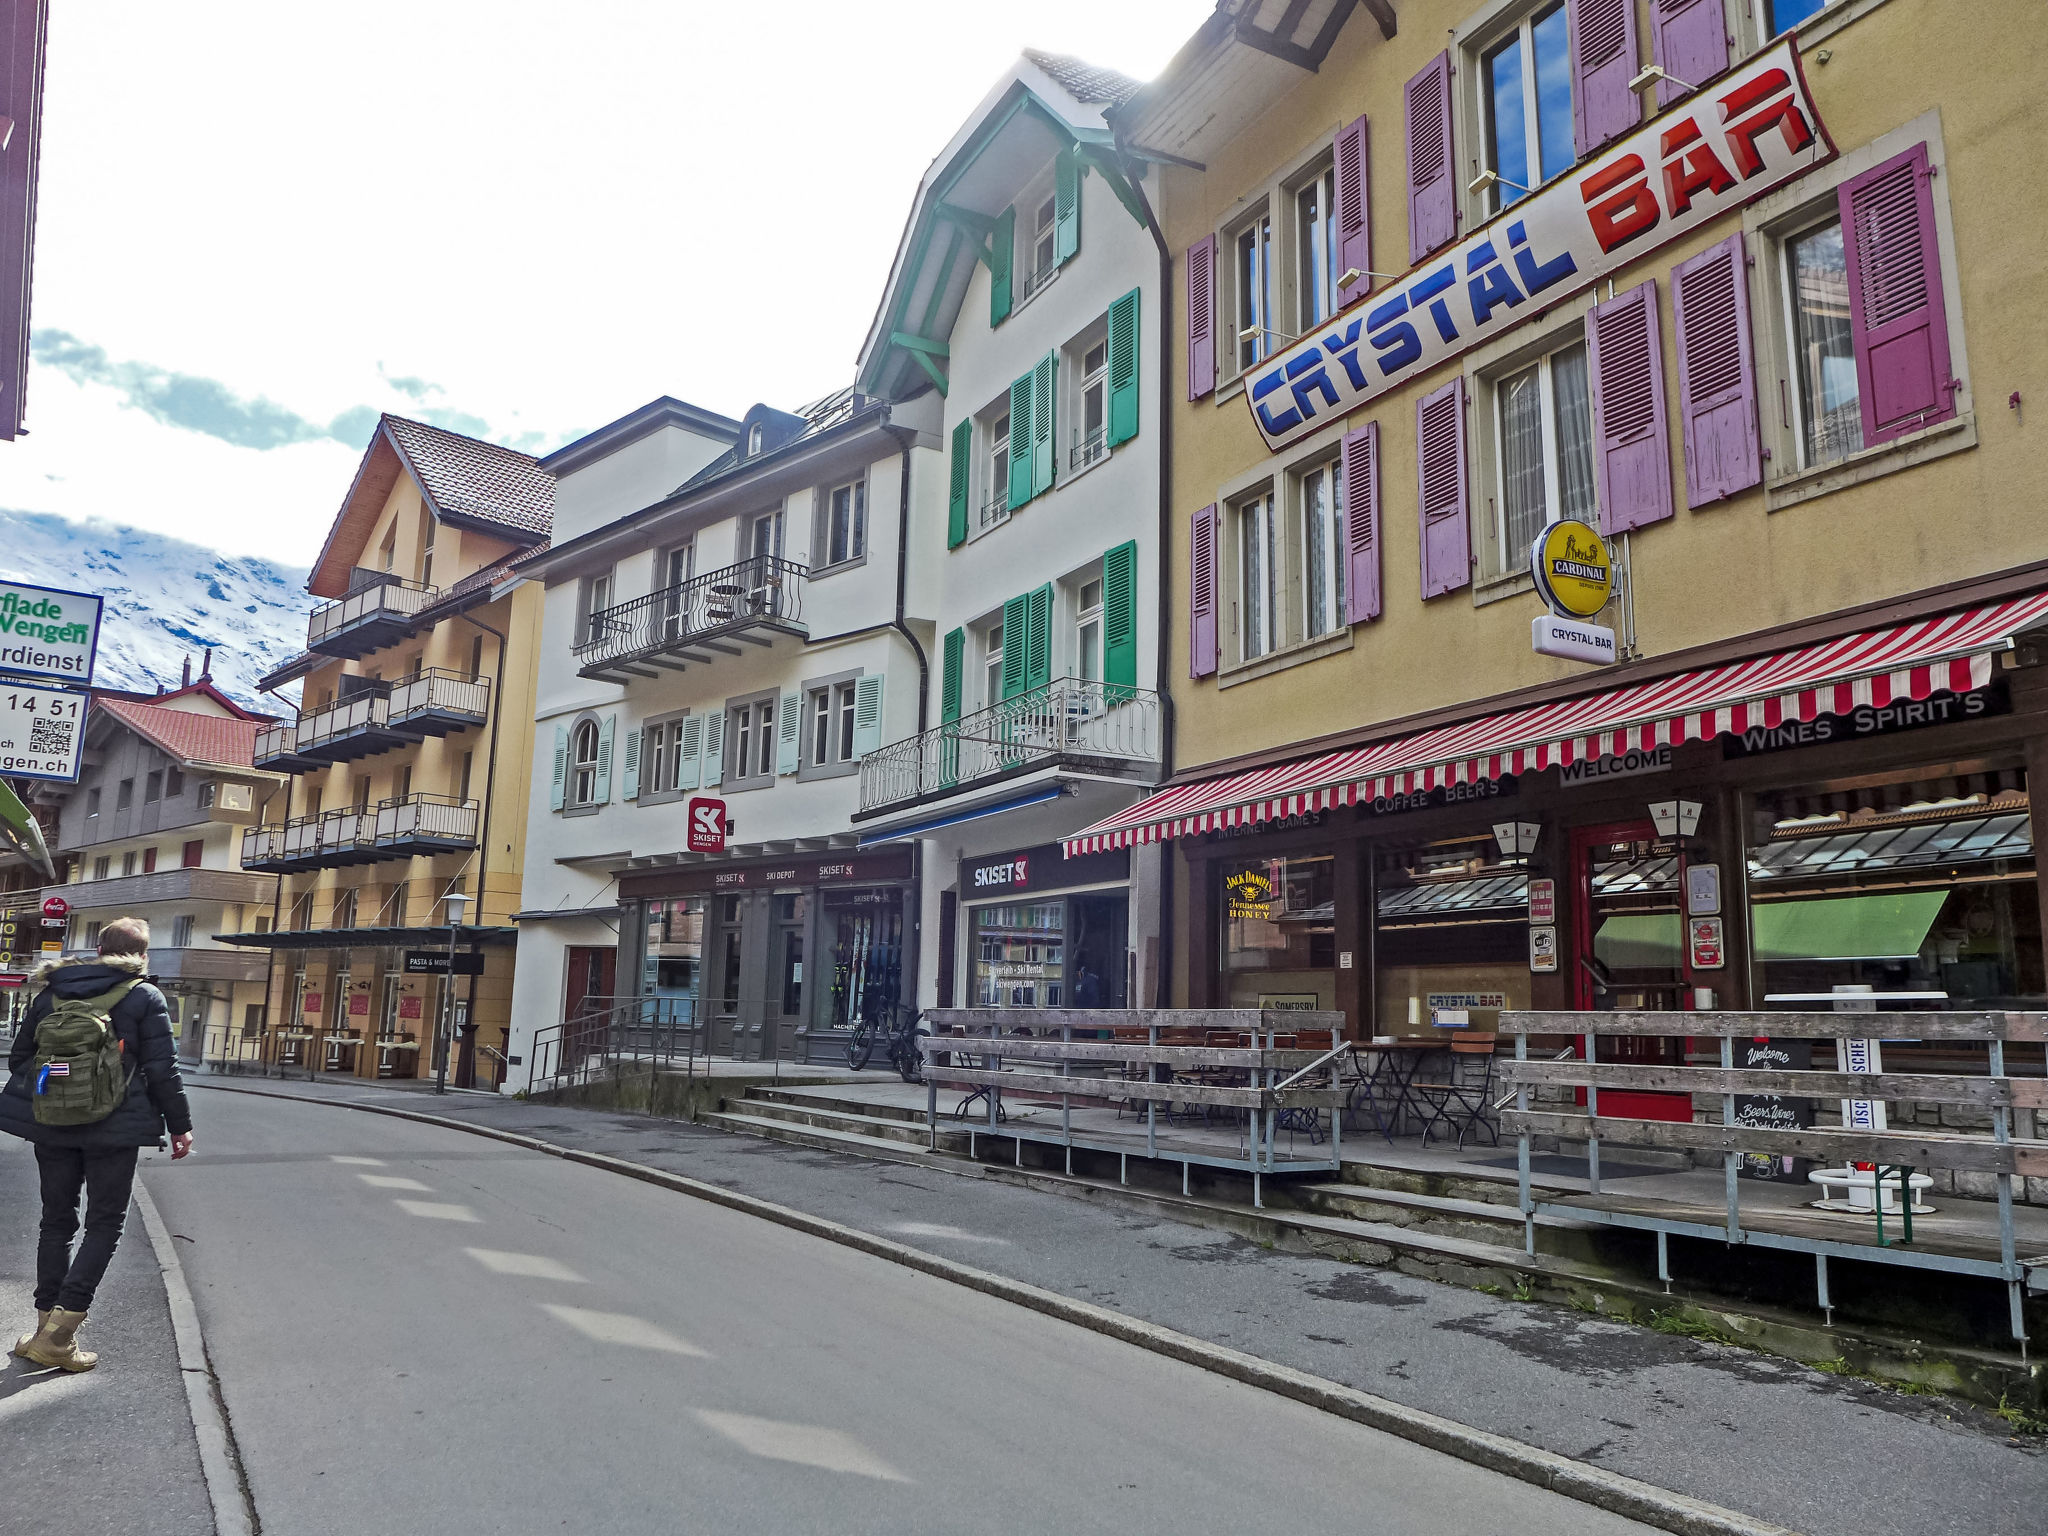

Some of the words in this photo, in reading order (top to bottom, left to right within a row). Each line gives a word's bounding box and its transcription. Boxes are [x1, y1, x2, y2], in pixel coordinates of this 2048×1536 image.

[1251, 218, 1578, 436] CRYSTAL
[1580, 67, 1816, 255] BAR
[1555, 560, 1605, 581] CARDINAL
[1552, 628, 1594, 645] CRYSTAL
[1595, 635, 1612, 650] BAR
[7, 693, 37, 713] 14
[49, 699, 78, 718] 51
[1741, 720, 1832, 752] WINES
[1855, 692, 1985, 733] SPIRIT'S
[1561, 746, 1672, 782] WELCOME
[1374, 792, 1429, 813] COFFEE
[1445, 779, 1500, 802] BEER'S
[693, 833, 722, 843] SKISET
[1218, 821, 1266, 839] INTERNET
[715, 873, 738, 882] SKISET
[766, 872, 776, 880] SKI
[776, 870, 795, 879] DEPOT
[819, 865, 844, 876] SKISET
[975, 863, 1014, 887] SKISET
[1226, 873, 1246, 890] JACK
[1229, 909, 1270, 920] HONEY
[0, 909, 17, 963] FOTO
[1017, 964, 1026, 975] Ski
[1027, 963, 1044, 975] Rental
[1429, 995, 1479, 1007] CRYSTAL
[1480, 995, 1503, 1007] BAR
[1747, 1045, 1790, 1066] Welcome
[1770, 1104, 1795, 1121] Wines
